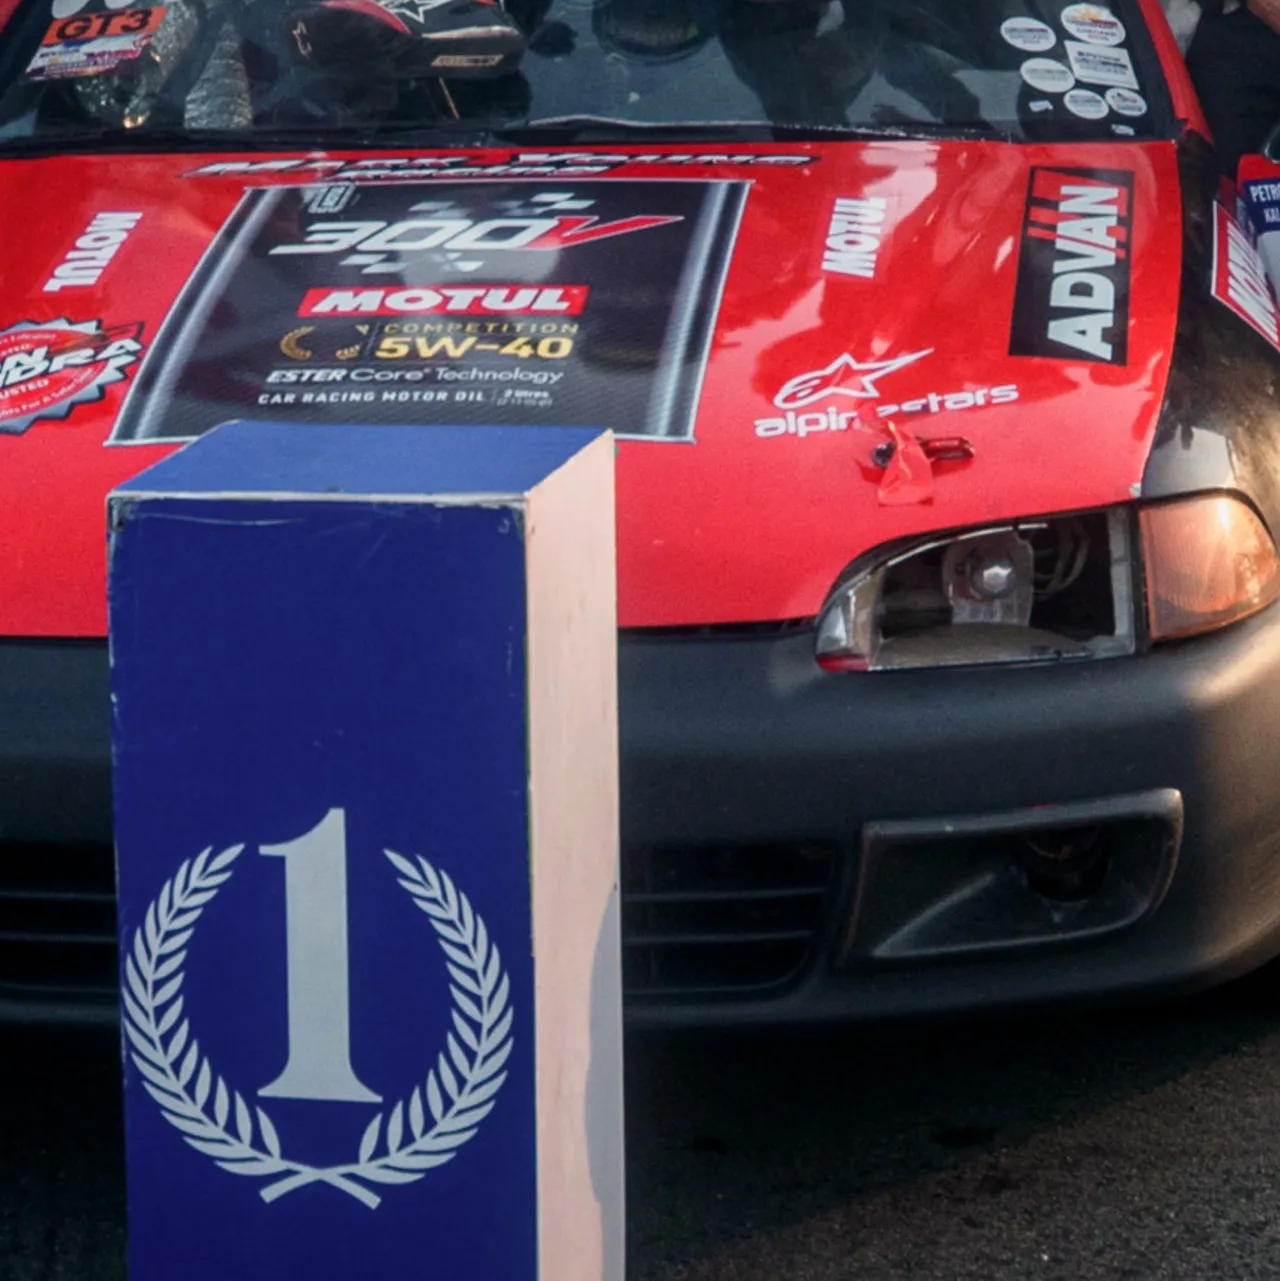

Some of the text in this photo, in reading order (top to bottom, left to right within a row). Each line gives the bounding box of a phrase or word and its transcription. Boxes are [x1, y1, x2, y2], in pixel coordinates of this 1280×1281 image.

[55, 8, 154, 41] GT3
[42, 211, 144, 293] MOTUL
[267, 215, 685, 256] 300V
[821, 195, 888, 279] MOTUL
[1046, 184, 1120, 362] ADVAN
[310, 286, 572, 315] MOTUL
[383, 322, 580, 335] COMPETITION
[374, 335, 574, 360] 5W-40
[435, 366, 564, 385] Technology
[257, 392, 298, 405] CAR
[301, 390, 376, 404] RACING
[380, 390, 453, 403] MOTOR
[454, 389, 487, 403] OIL
[257, 806, 384, 1104] 1
